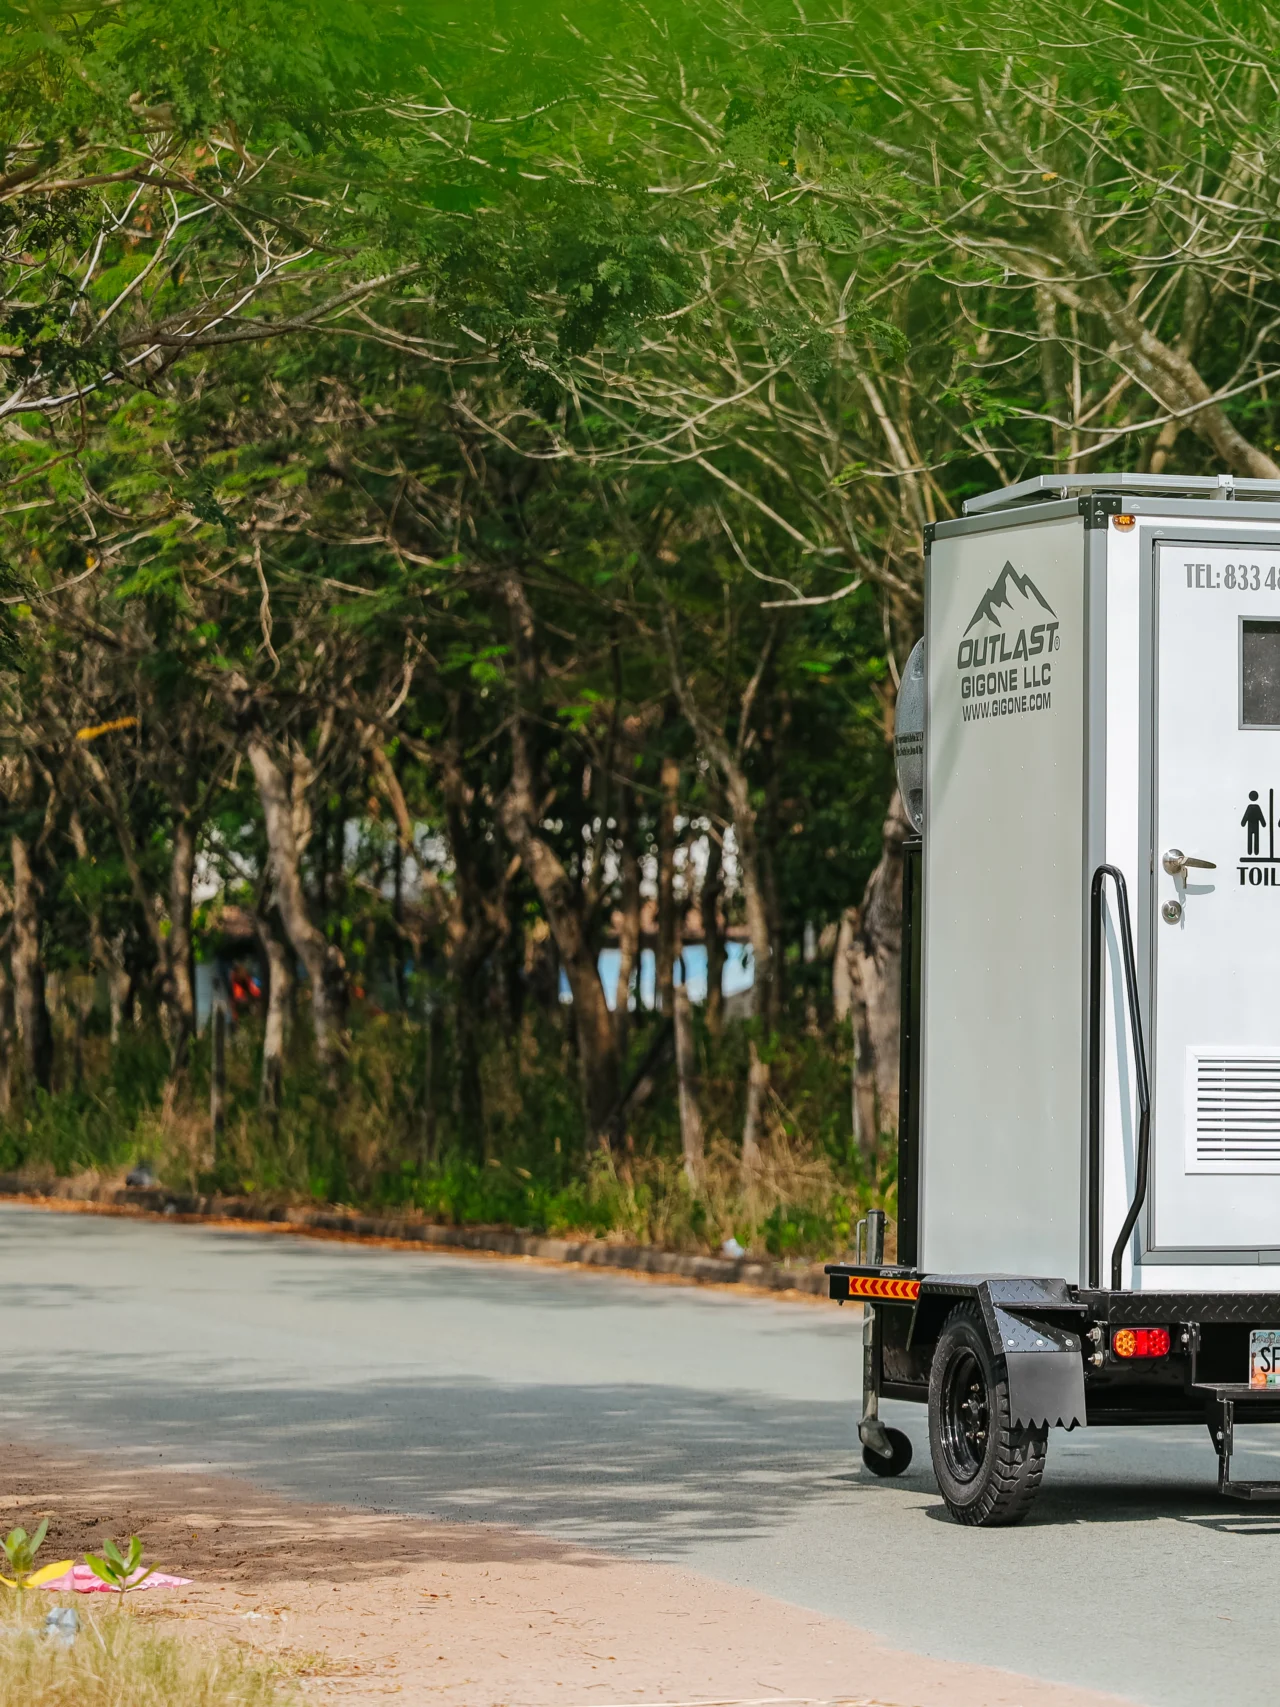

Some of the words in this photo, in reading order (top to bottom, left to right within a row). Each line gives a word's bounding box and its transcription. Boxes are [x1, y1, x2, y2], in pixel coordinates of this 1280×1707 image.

[1224, 564, 1261, 591] 833
[957, 621, 1059, 669] OUTLAST
[961, 668, 1018, 699] GIGONE
[1024, 663, 1051, 689] LLC
[962, 692, 1051, 722] WWW.GIGONE.COM
